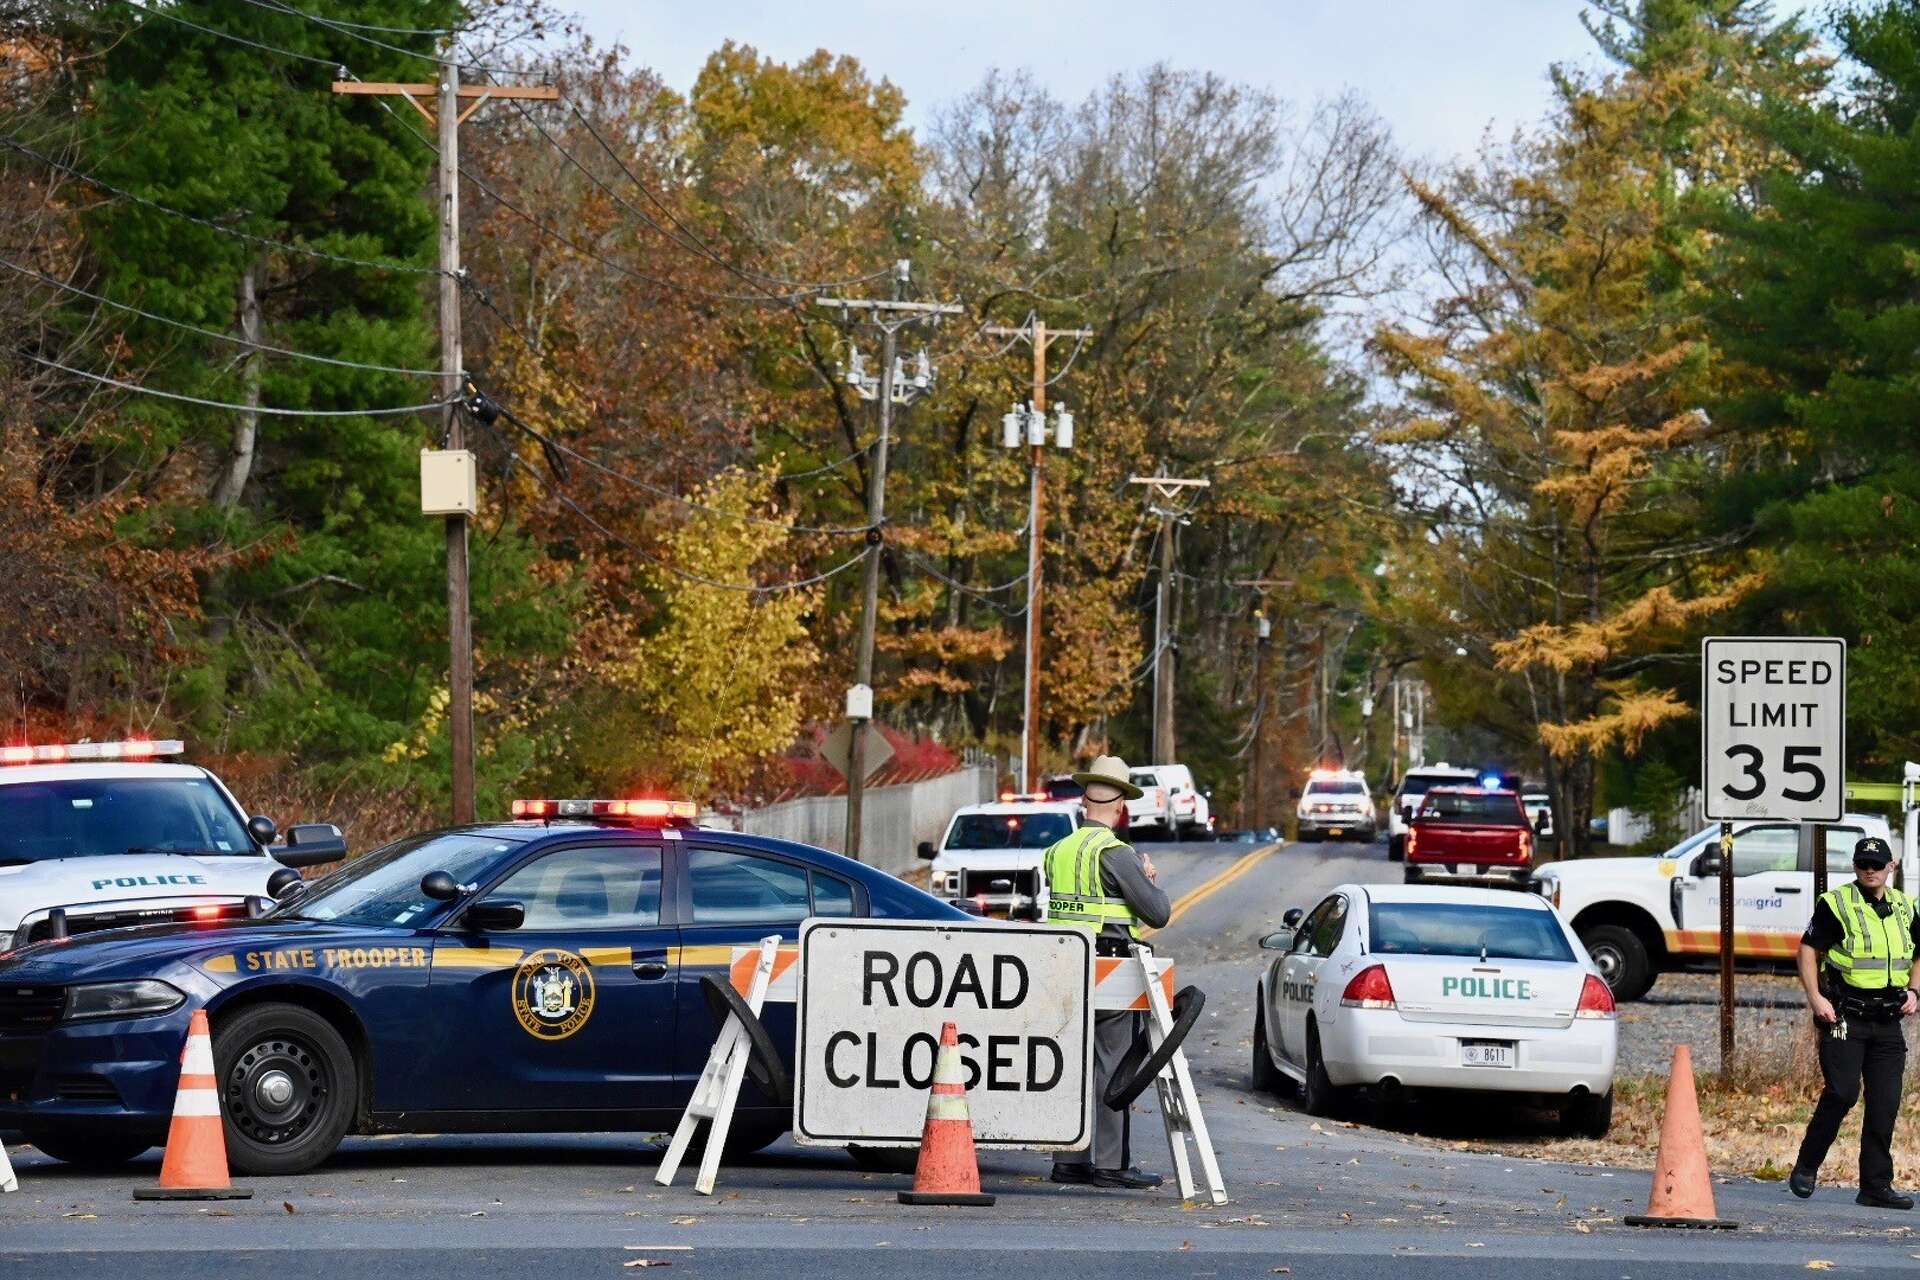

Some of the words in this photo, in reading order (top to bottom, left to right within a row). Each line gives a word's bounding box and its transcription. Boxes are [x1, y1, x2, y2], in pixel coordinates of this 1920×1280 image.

[1717, 659, 1832, 685] SPEED
[1729, 702, 1819, 728] LIMIT
[1721, 743, 1826, 802] 35
[91, 874, 208, 891] POLICE
[1708, 895, 1783, 910] naonalgrid
[246, 950, 316, 972] STATE
[322, 947, 427, 969] TROOPER
[862, 950, 1030, 1010] ROAD
[1282, 981, 1314, 1004] POLICE
[1442, 976, 1531, 1000] POLICE
[518, 999, 543, 1032] STATE
[561, 998, 592, 1033] POLICE
[824, 1030, 1064, 1092] CLOSED
